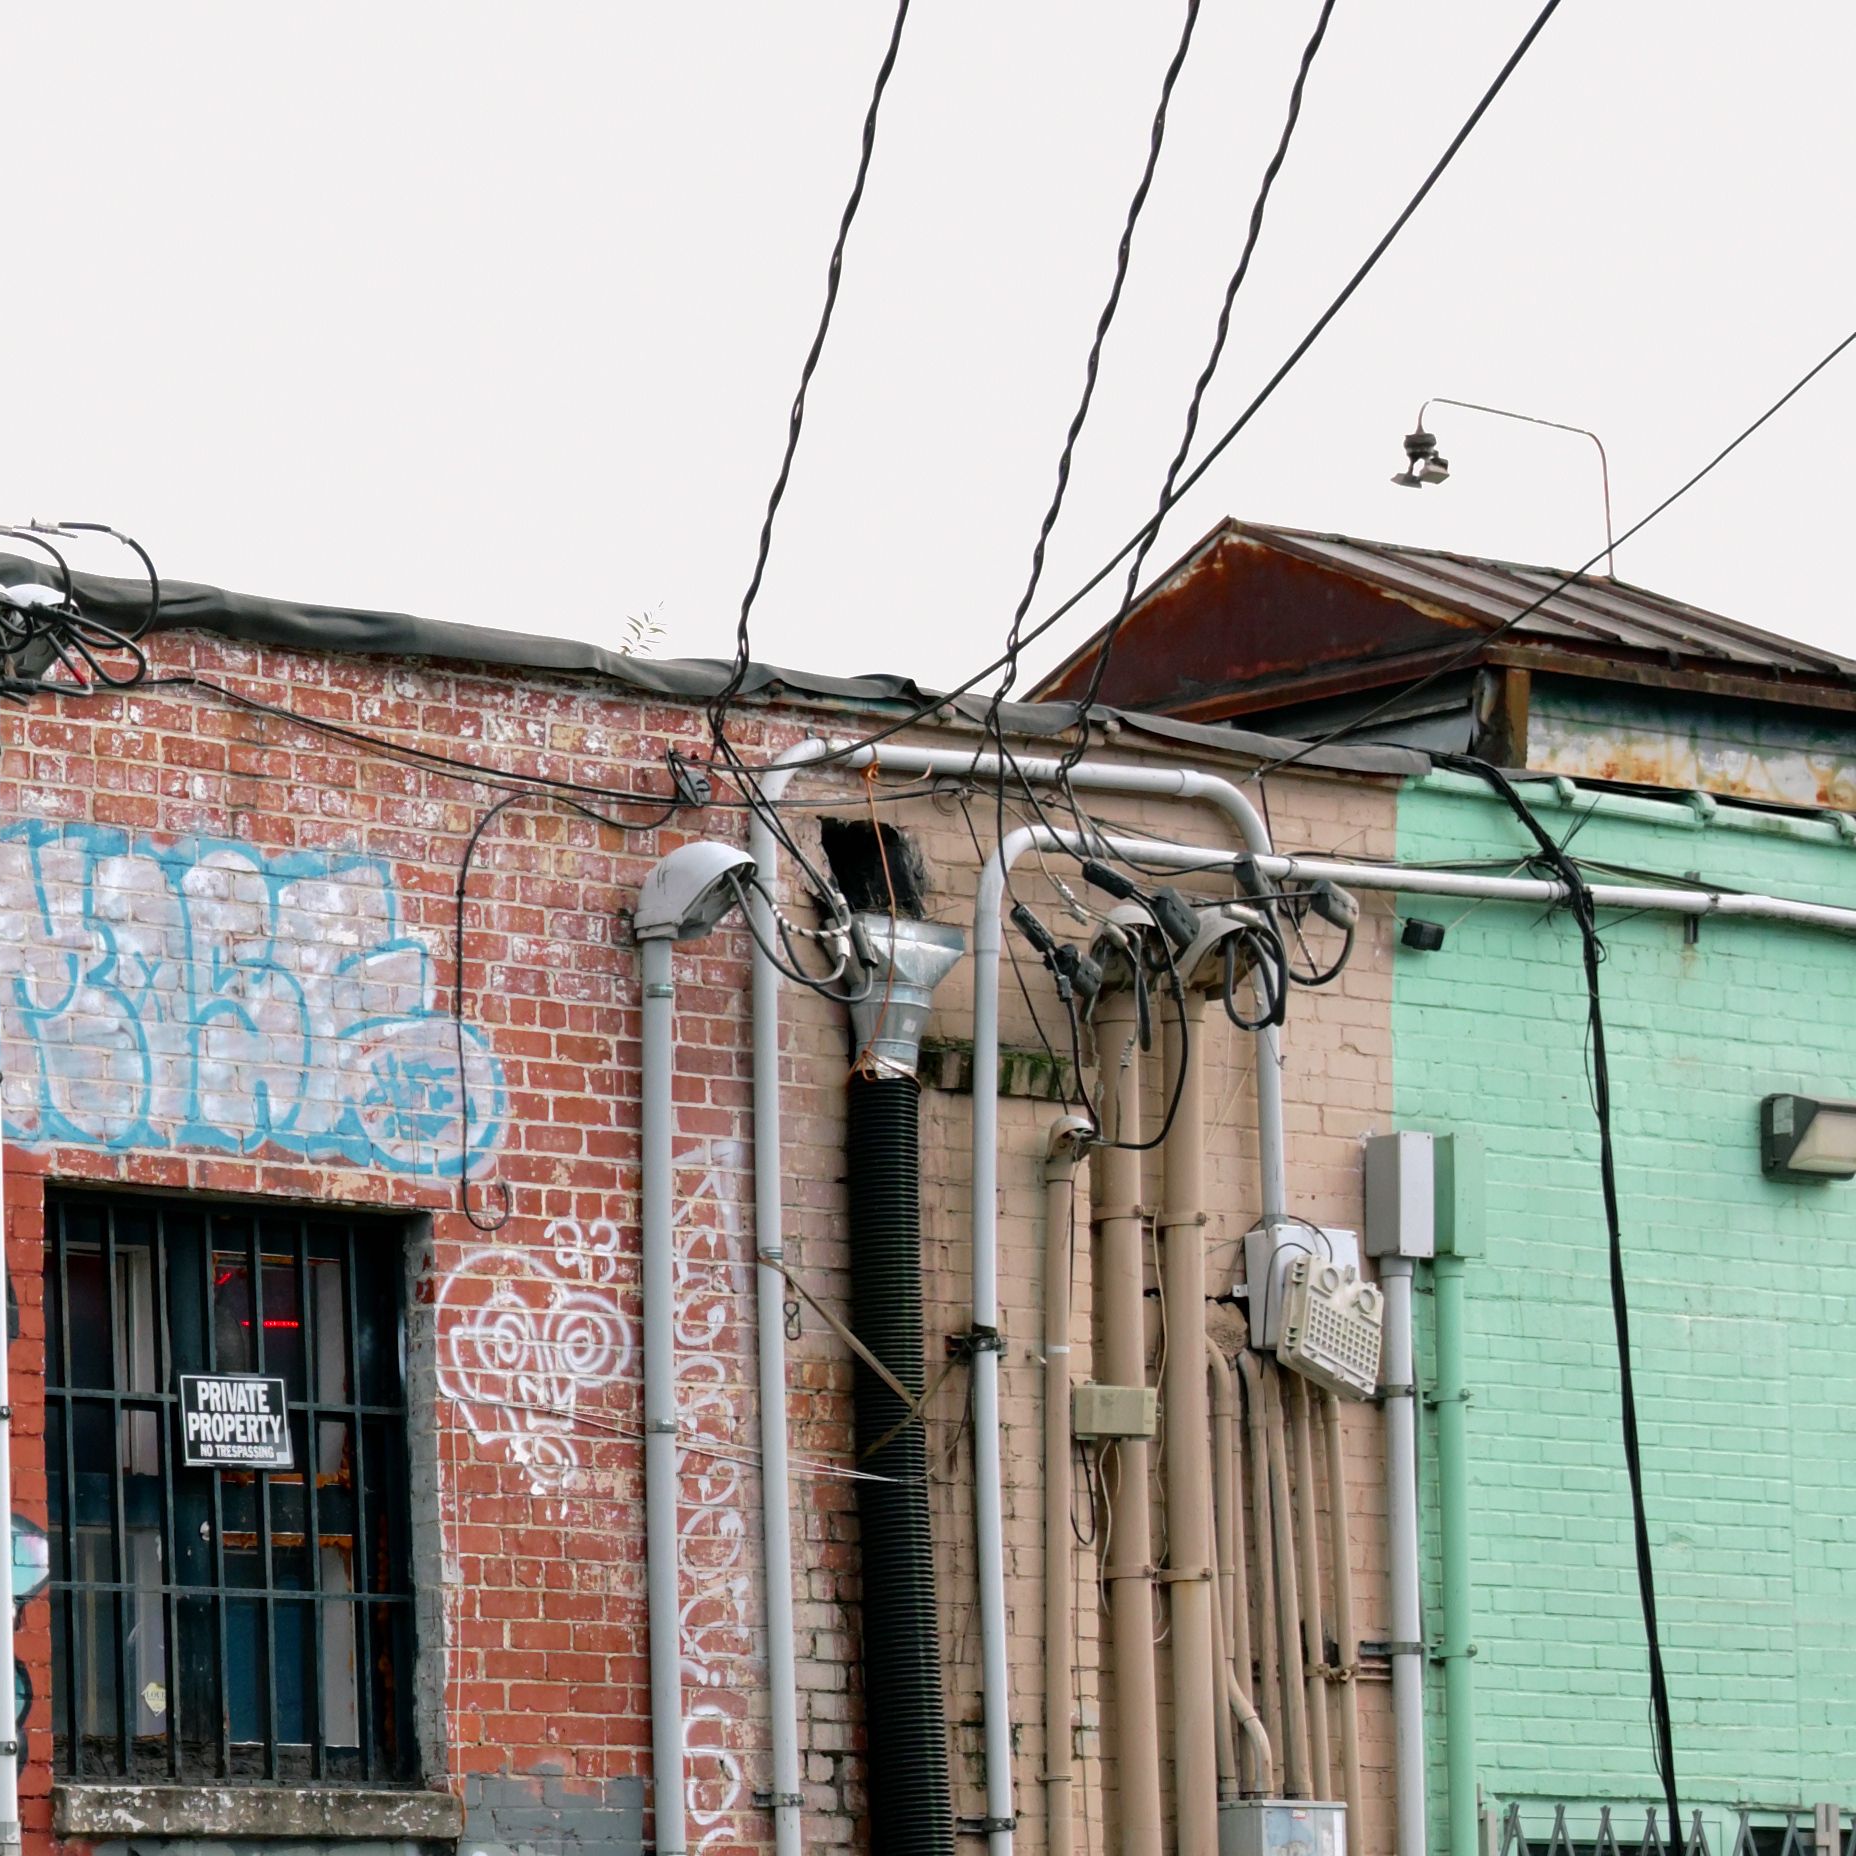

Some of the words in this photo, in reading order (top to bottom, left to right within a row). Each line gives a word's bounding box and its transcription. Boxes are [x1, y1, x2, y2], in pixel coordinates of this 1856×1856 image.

[197, 1381, 270, 1413] PRIVATE
[188, 1412, 281, 1443] PROPERTY
[200, 1444, 213, 1457] NO
[215, 1444, 274, 1459] TRESPASSING
